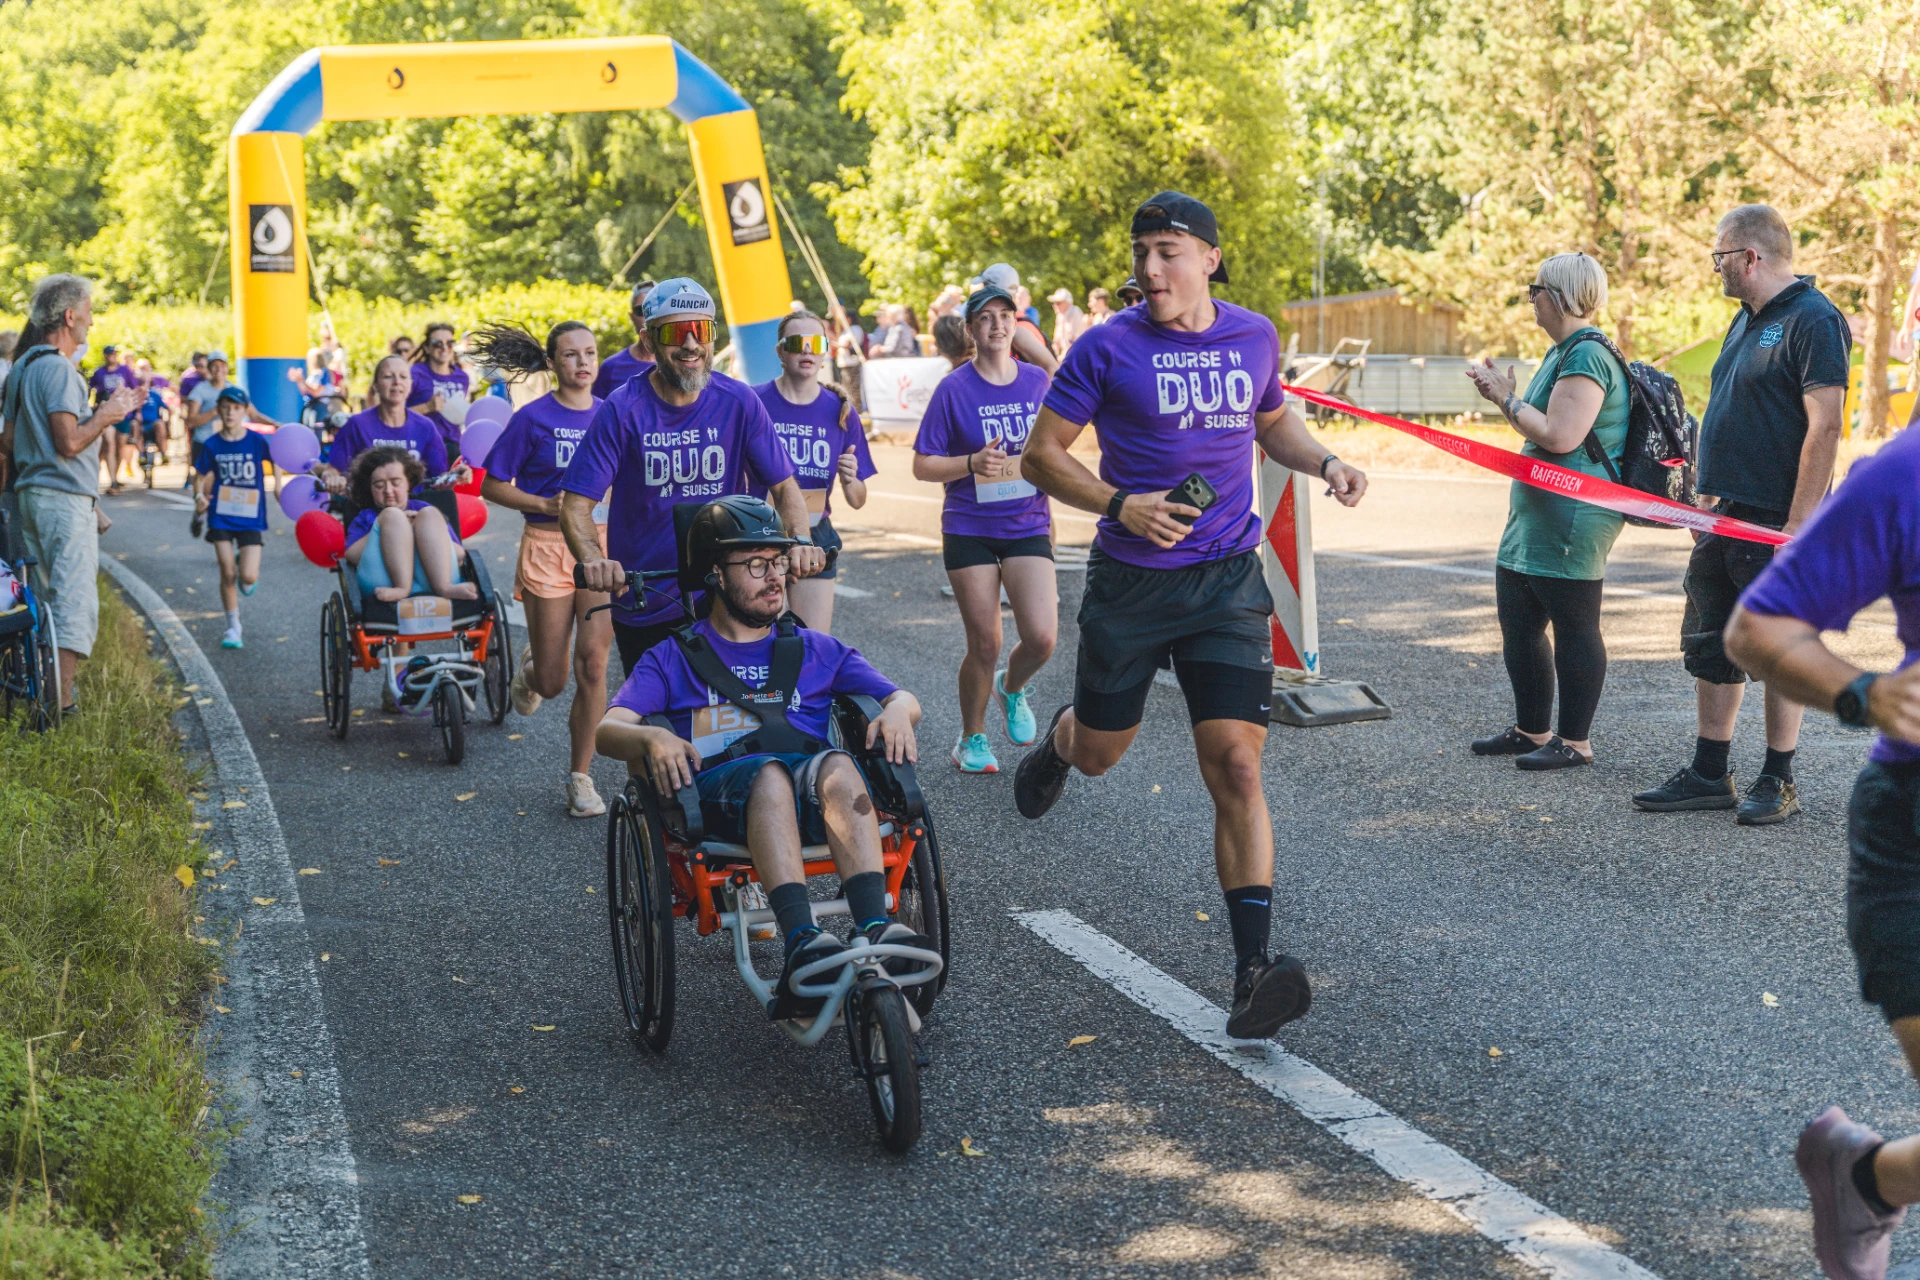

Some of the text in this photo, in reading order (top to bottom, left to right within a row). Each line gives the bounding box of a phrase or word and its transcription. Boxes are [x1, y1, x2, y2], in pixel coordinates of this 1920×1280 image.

[670, 298, 709, 309] BIANCHI
[1152, 351, 1222, 369] COURSE
[1156, 369, 1254, 414] DUO
[978, 402, 1023, 417] COURSE
[1204, 413, 1250, 429] SUISSE
[643, 429, 701, 447] COURSE
[1424, 431, 1471, 457] RAIFFEISEN
[644, 444, 726, 487] DUO
[798, 466, 830, 479] SUISSE
[1530, 464, 1584, 493] RAIFFEISEN
[682, 481, 725, 498] SUISSE
[1644, 500, 1708, 526] RAIFFEISEN
[413, 599, 437, 617] 112
